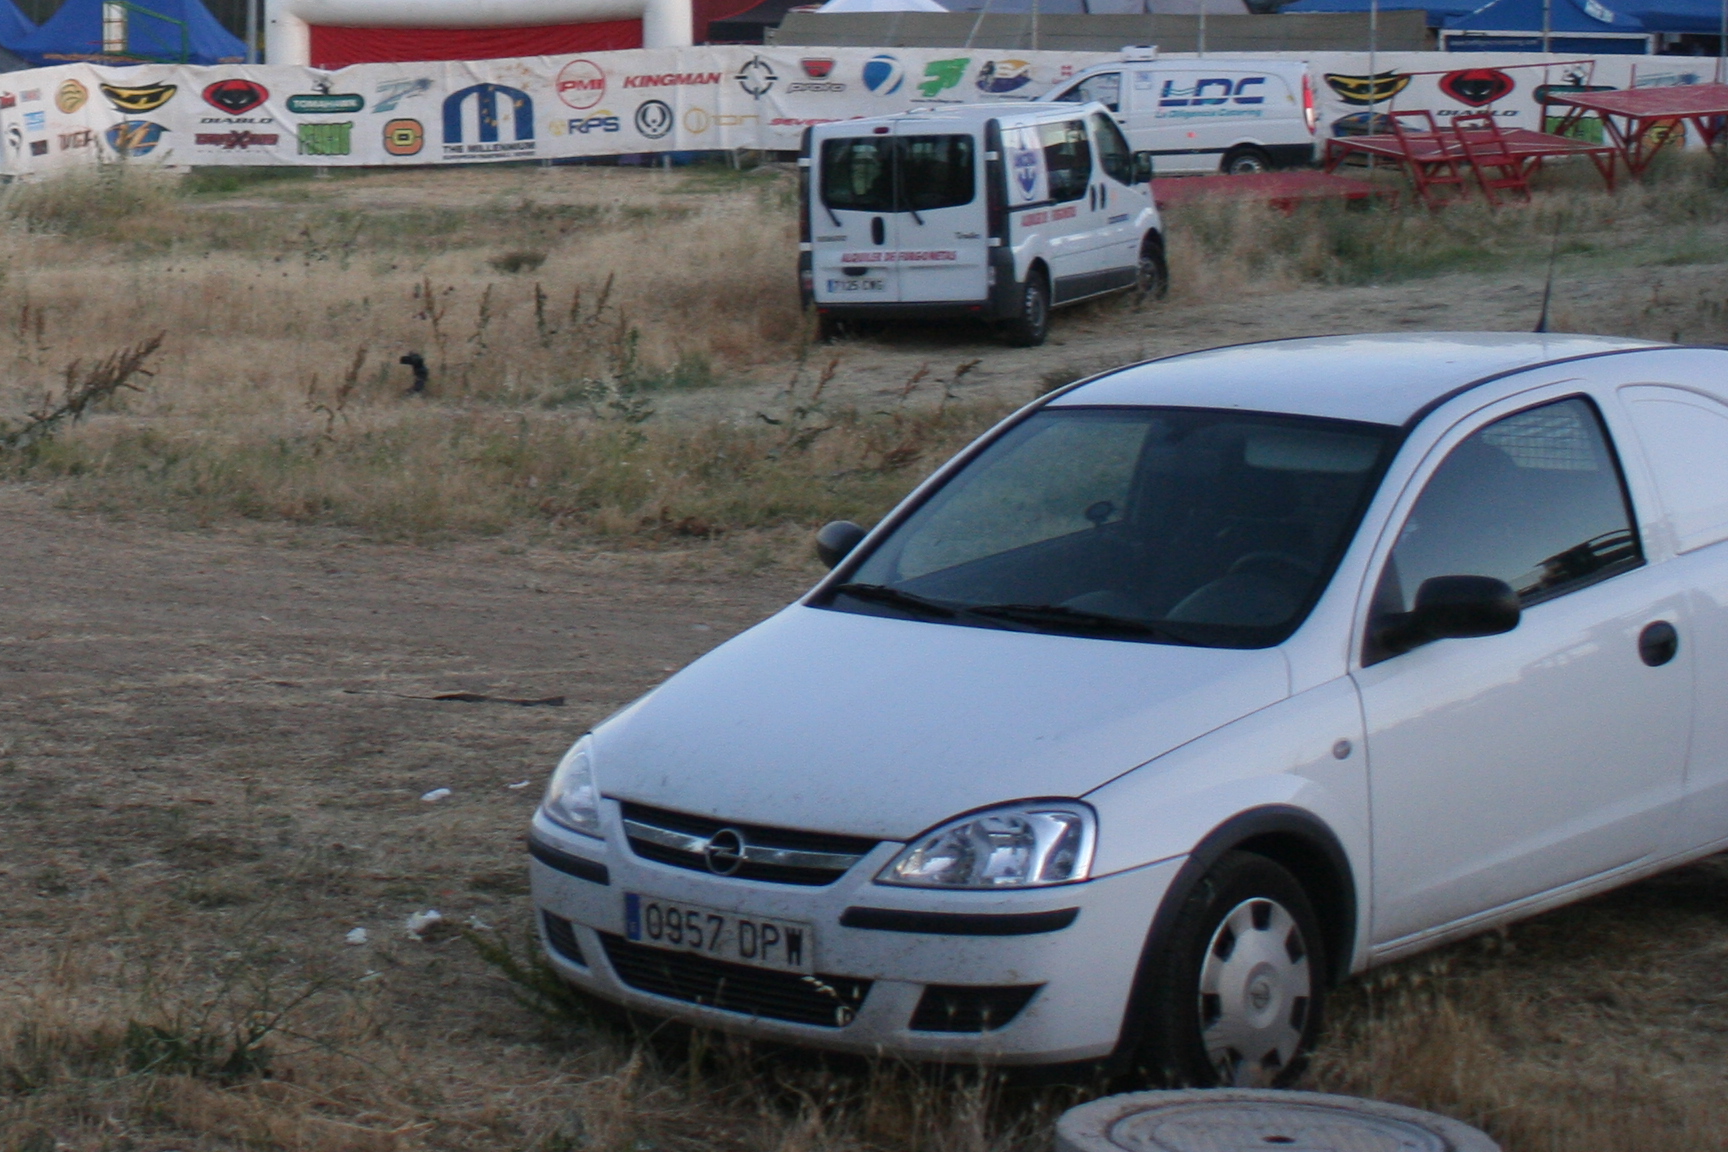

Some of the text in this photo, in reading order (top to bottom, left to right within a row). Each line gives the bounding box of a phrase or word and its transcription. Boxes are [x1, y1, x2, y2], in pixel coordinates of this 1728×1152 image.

[559, 78, 605, 93] PMI
[623, 72, 722, 89] KINGMAN
[1158, 76, 1266, 107] LDC
[568, 116, 620, 135] RPS
[645, 902, 804, 967] 0957 DPW
